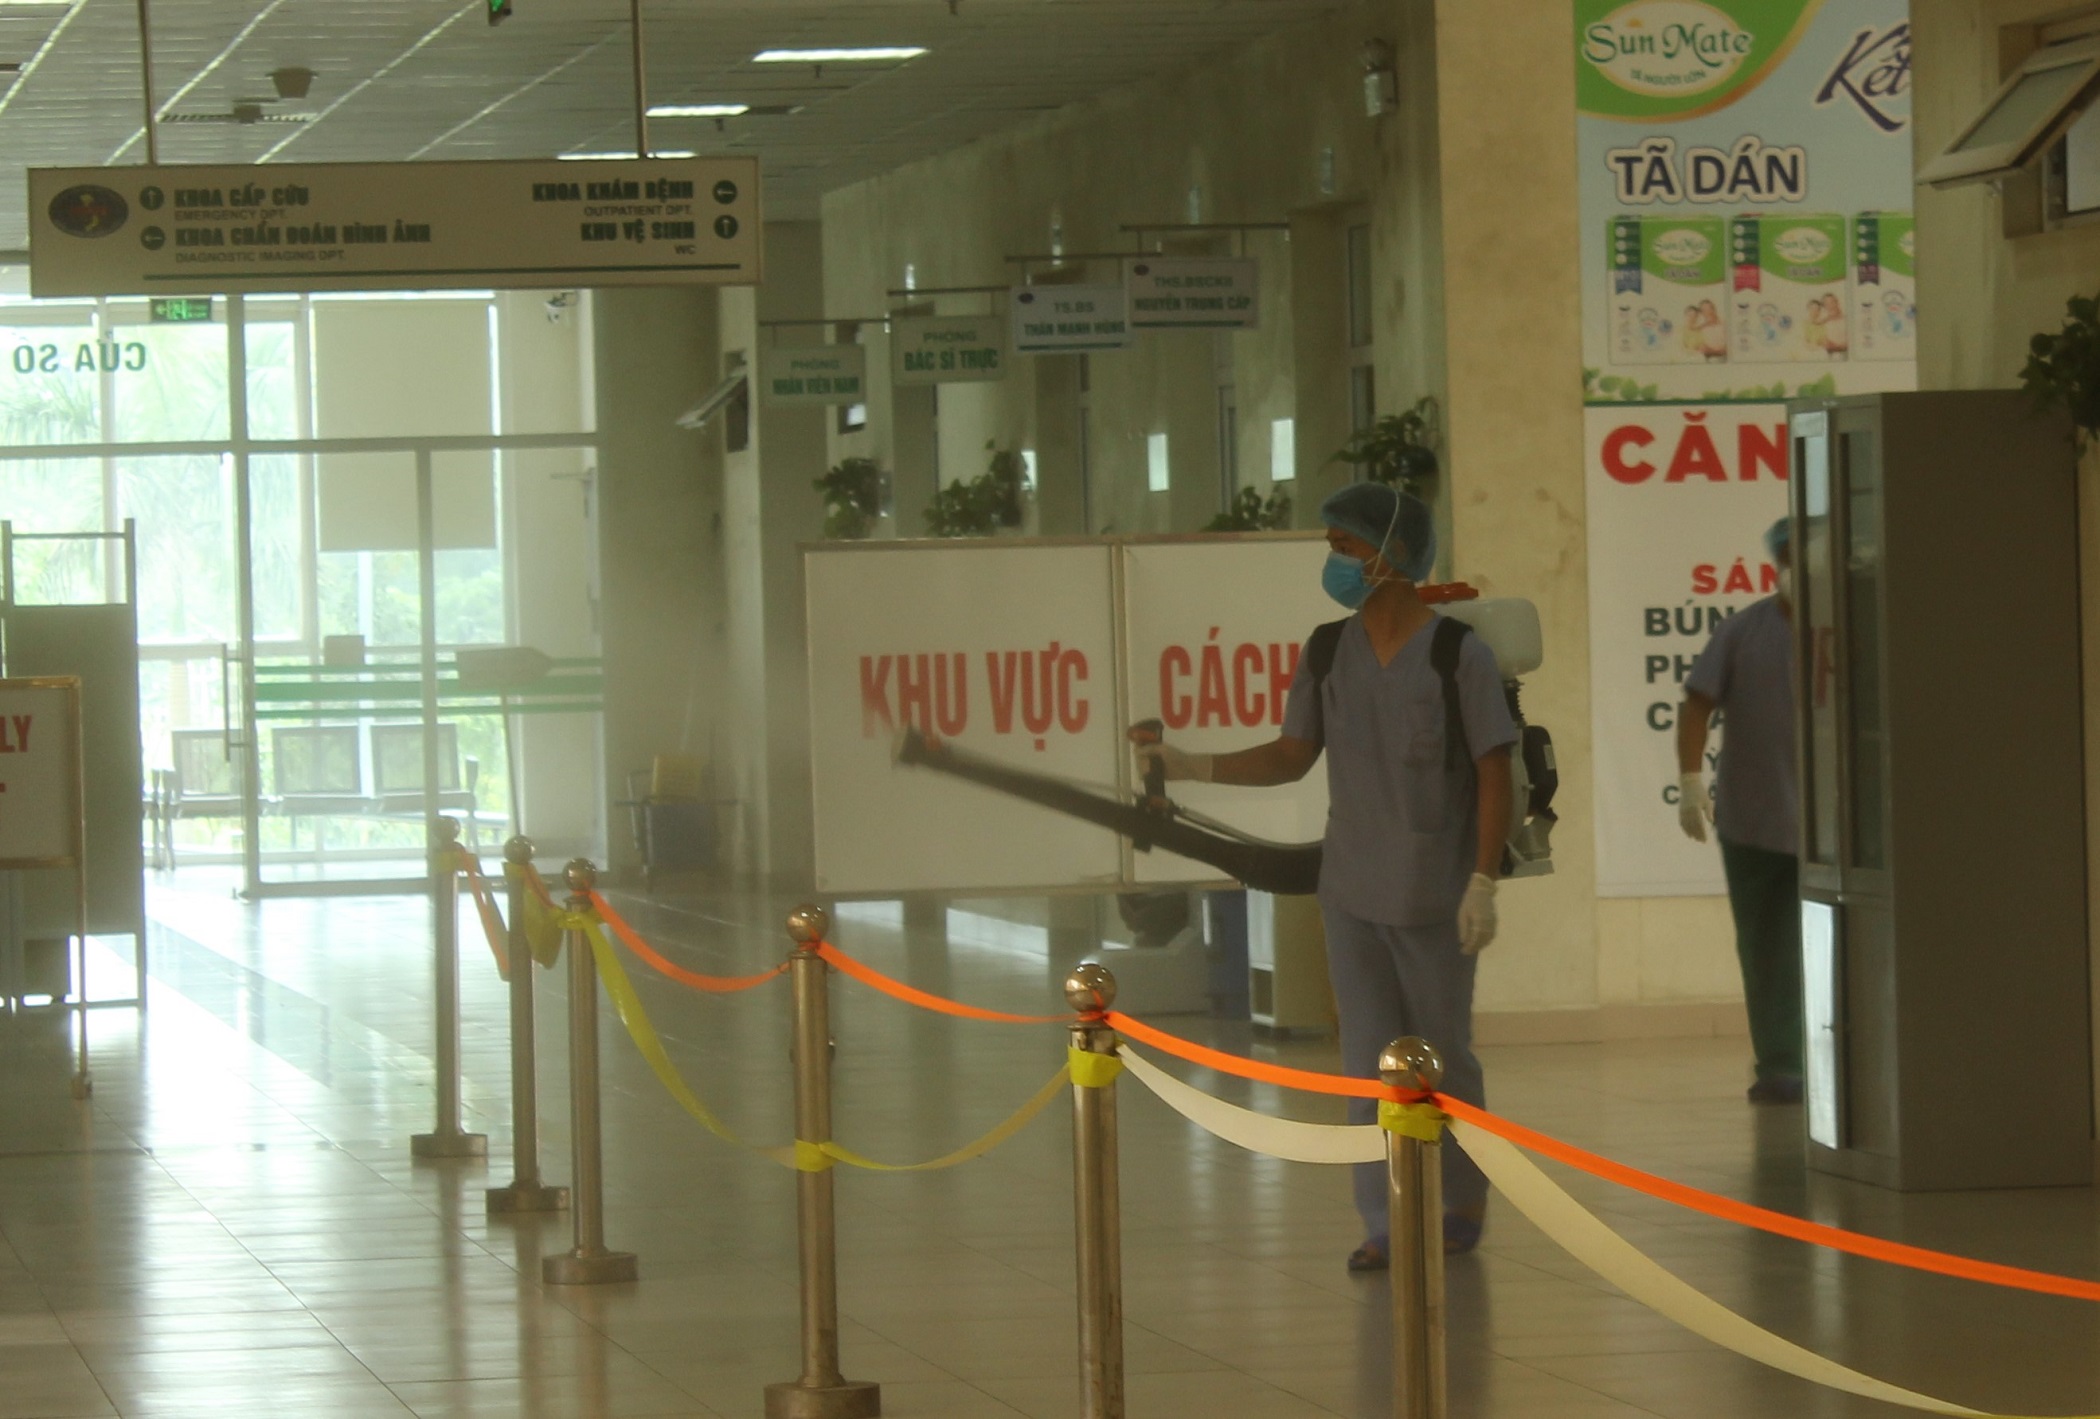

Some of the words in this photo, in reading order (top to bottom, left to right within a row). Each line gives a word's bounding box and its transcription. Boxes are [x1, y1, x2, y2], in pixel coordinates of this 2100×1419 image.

[1584, 24, 1655, 63] Sun
[1662, 23, 1750, 68] Mate
[1614, 145, 1675, 196] TÃ
[1693, 143, 1799, 195] DÁN
[174, 188, 223, 207] KHOA
[532, 182, 581, 201] KHOA
[174, 209, 257, 221] EMERGENCY
[584, 204, 662, 216] OUTPATIENT
[175, 227, 224, 246] KHOA
[580, 222, 617, 241] KHU
[651, 221, 695, 239] SINH
[175, 251, 255, 263] DIAGNOSTIC
[674, 244, 696, 255] WC
[859, 652, 968, 740] KHU
[986, 641, 1089, 751] VỰC
[1159, 626, 1300, 730] CÁCH
